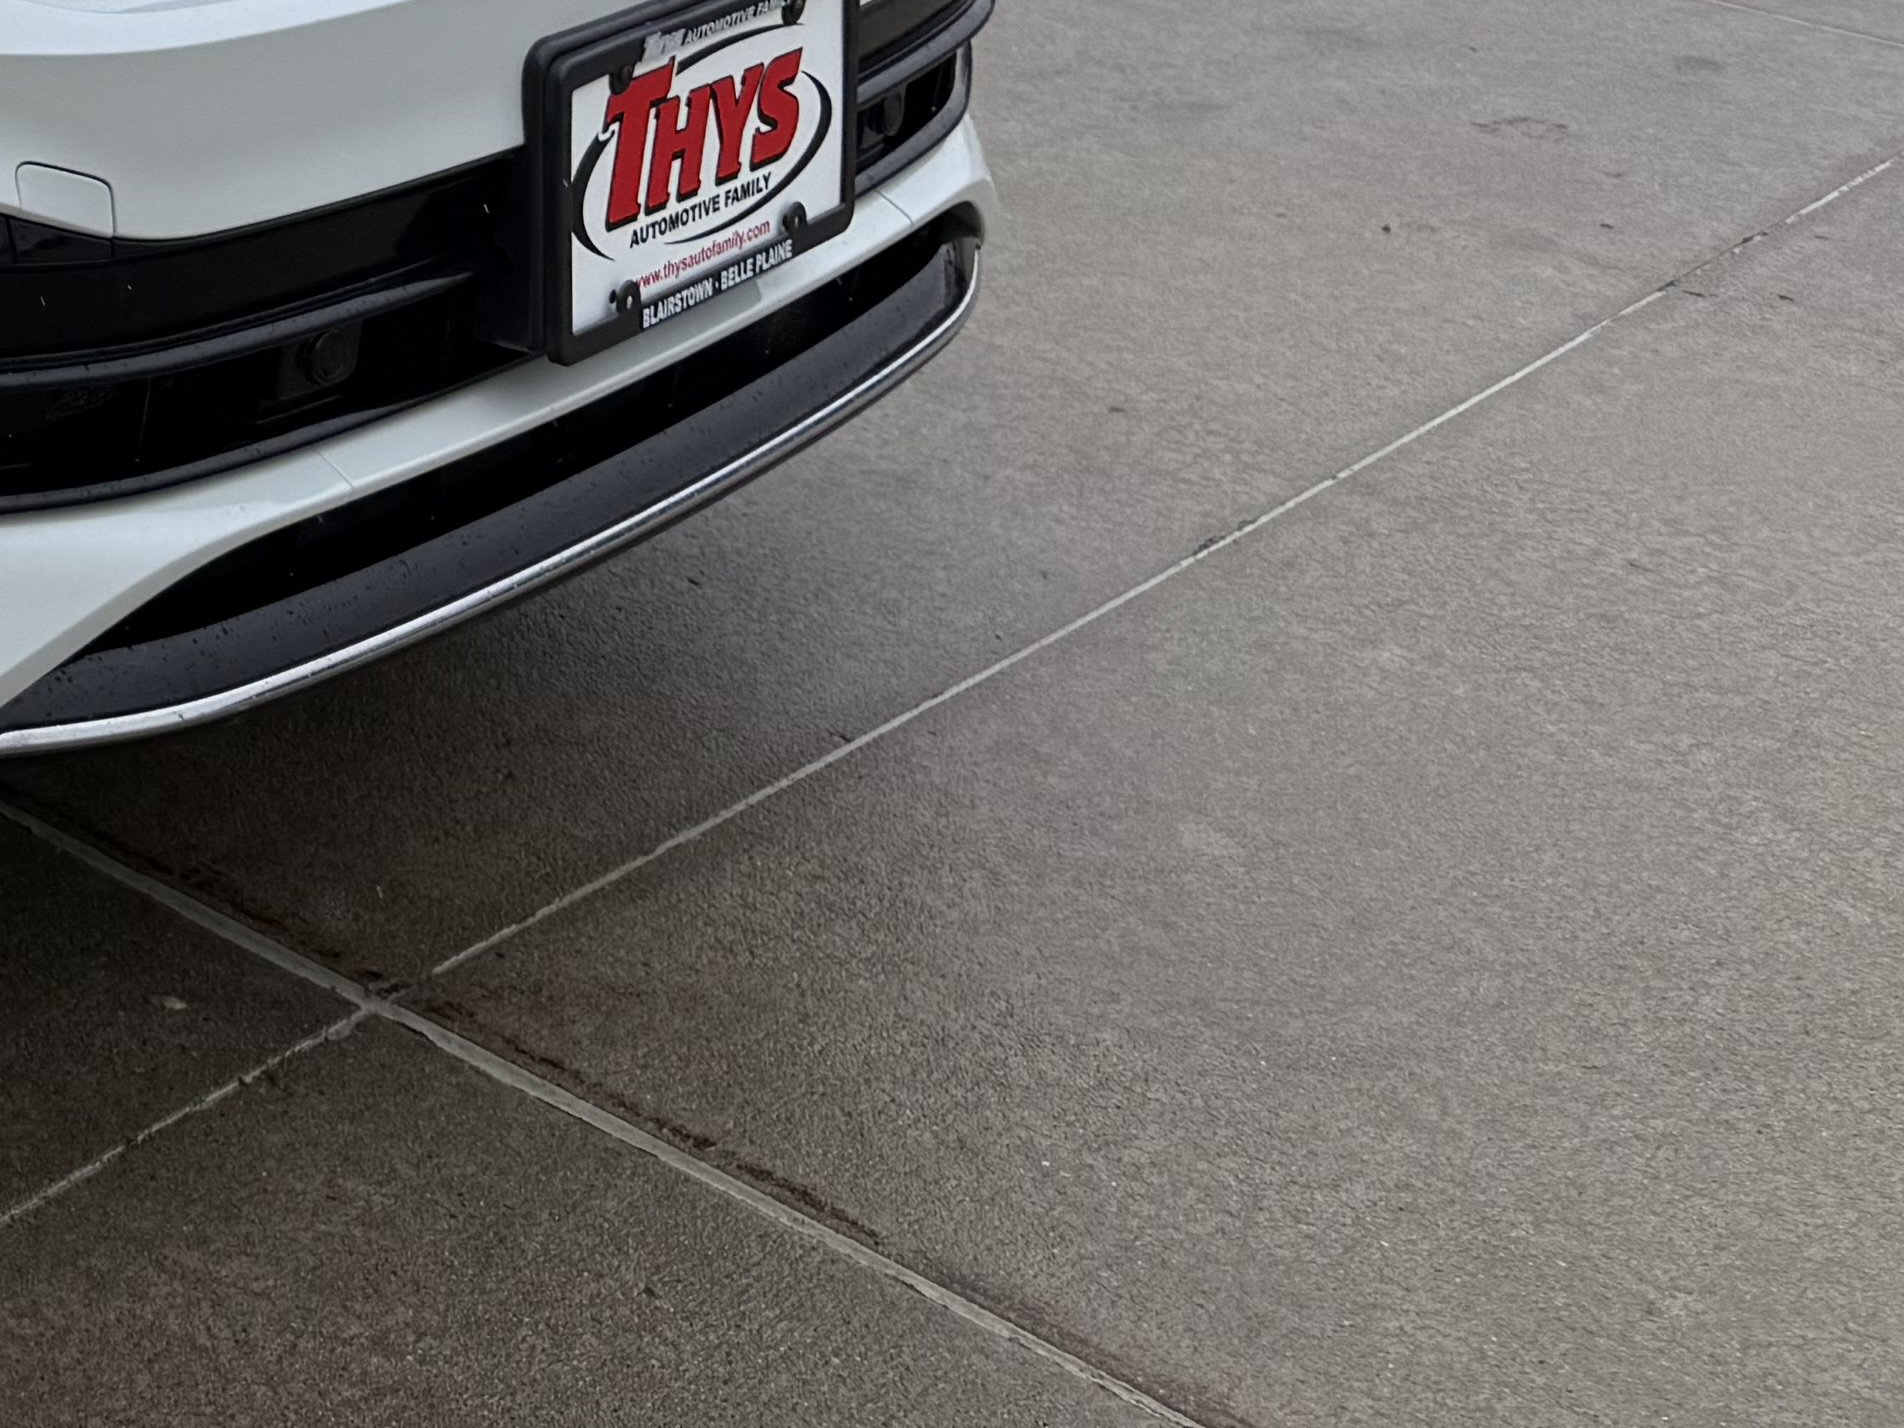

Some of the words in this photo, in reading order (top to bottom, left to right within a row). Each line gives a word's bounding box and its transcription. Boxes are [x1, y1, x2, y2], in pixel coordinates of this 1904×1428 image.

[685, 5, 756, 44] AUTOMOTIVE
[605, 47, 803, 231] THYS
[629, 194, 721, 249] AUTOMOTIVE
[724, 171, 772, 208] FAMILY
[642, 277, 713, 329] BLAIRSTOWN
[720, 258, 755, 291] BELLE
[755, 239, 793, 274] PLAINE
